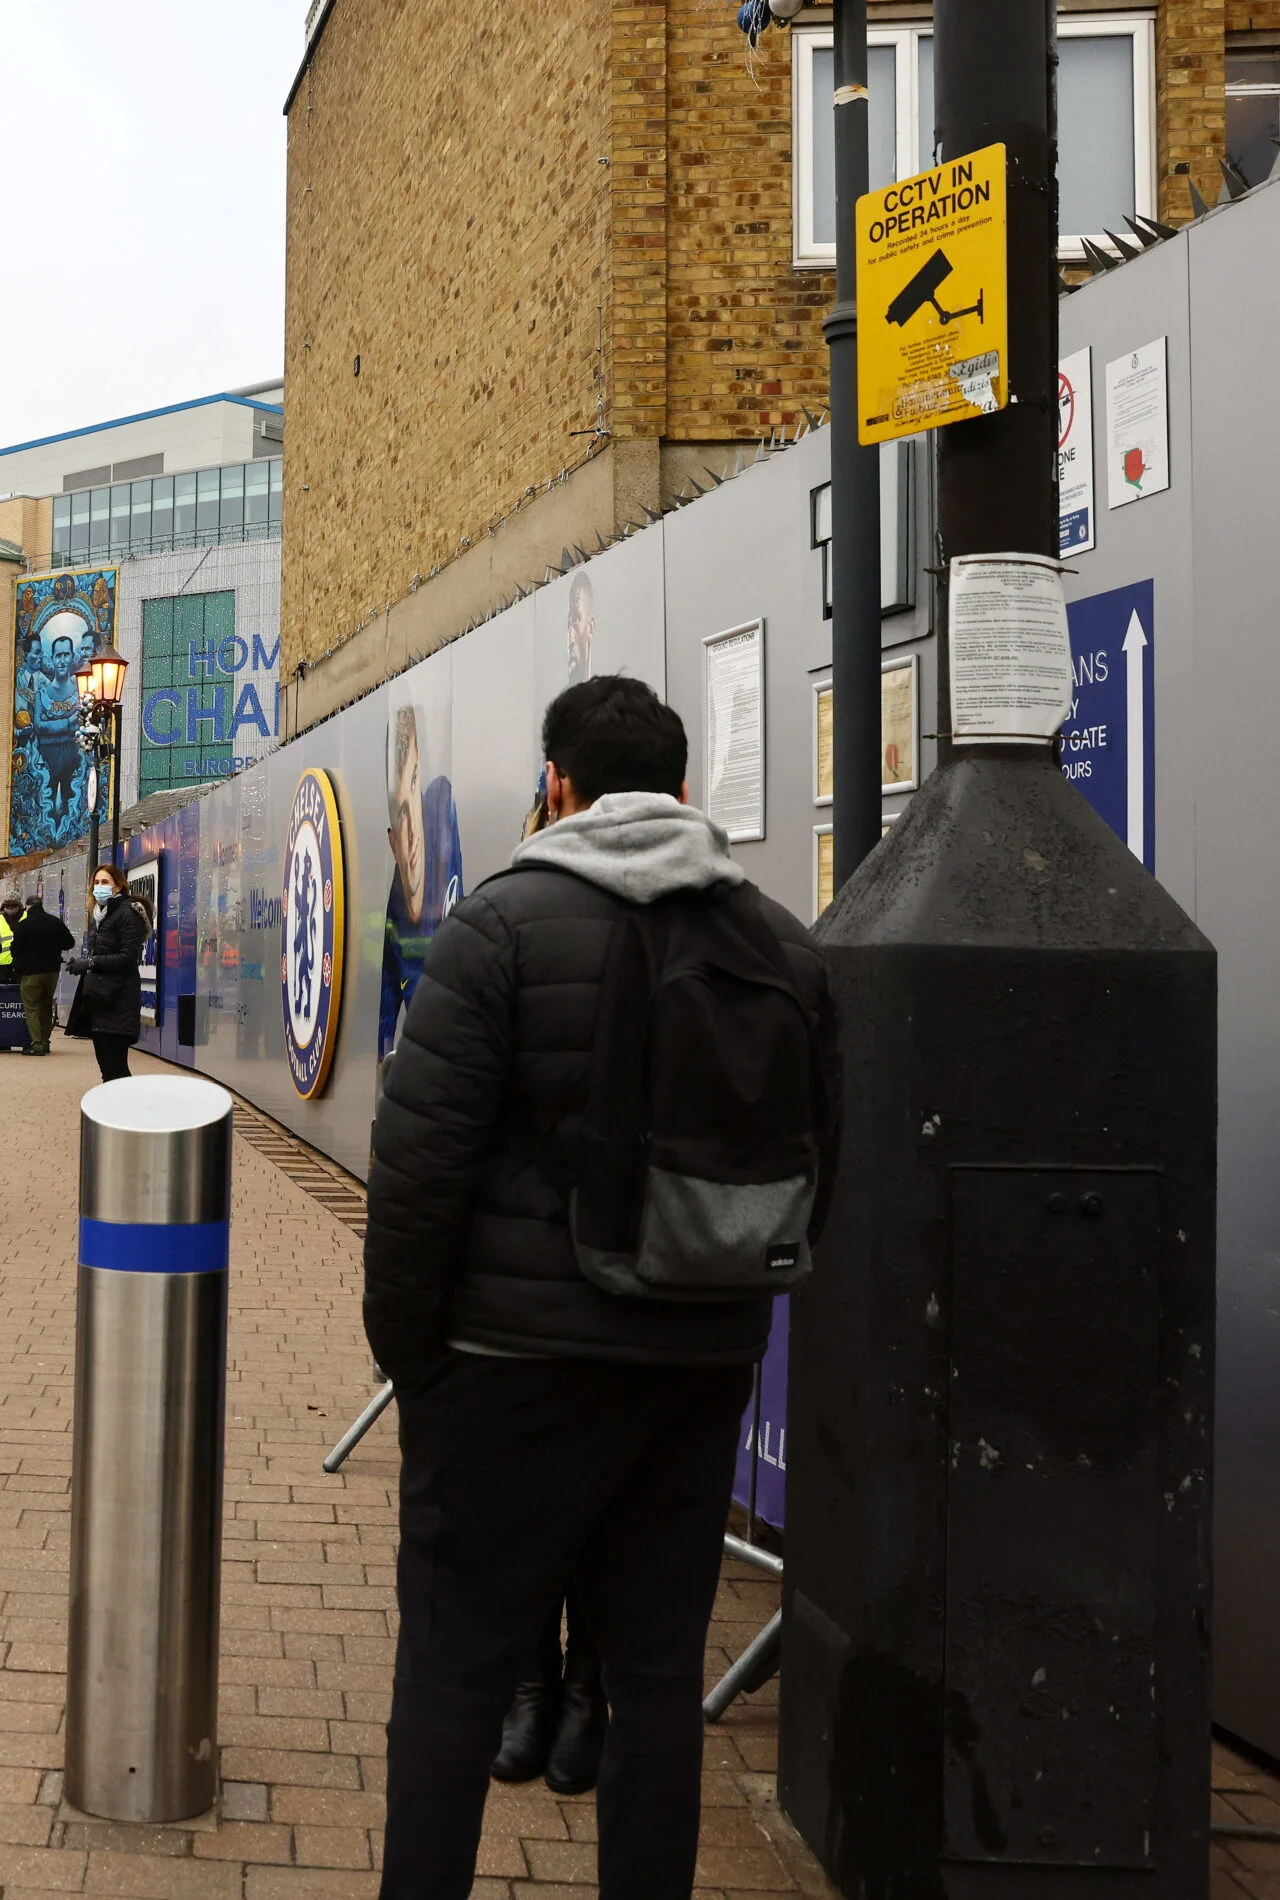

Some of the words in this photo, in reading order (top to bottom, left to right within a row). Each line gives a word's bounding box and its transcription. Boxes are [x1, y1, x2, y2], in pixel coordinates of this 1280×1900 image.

[884, 173, 941, 212] CCTV
[952, 161, 972, 187] IN
[869, 180, 990, 243] OPERATION
[887, 234, 917, 249] Recorded
[920, 230, 928, 238] 24
[930, 222, 948, 233] hours
[958, 215, 970, 224] day
[879, 251, 898, 262] public
[900, 242, 920, 255] safety
[922, 238, 934, 246] and
[936, 230, 954, 240] crime
[957, 216, 992, 233] prevention
[1058, 448, 1076, 466] ONE
[188, 634, 280, 678] HOM
[142, 682, 280, 746] CHA
[1070, 725, 1107, 752] GATE
[1062, 760, 1092, 780] OURS
[290, 782, 326, 852] CHELSEA
[250, 888, 282, 931] Welcom
[286, 1021, 308, 1082] FOOTBALL
[310, 1026, 322, 1074] CLUB
